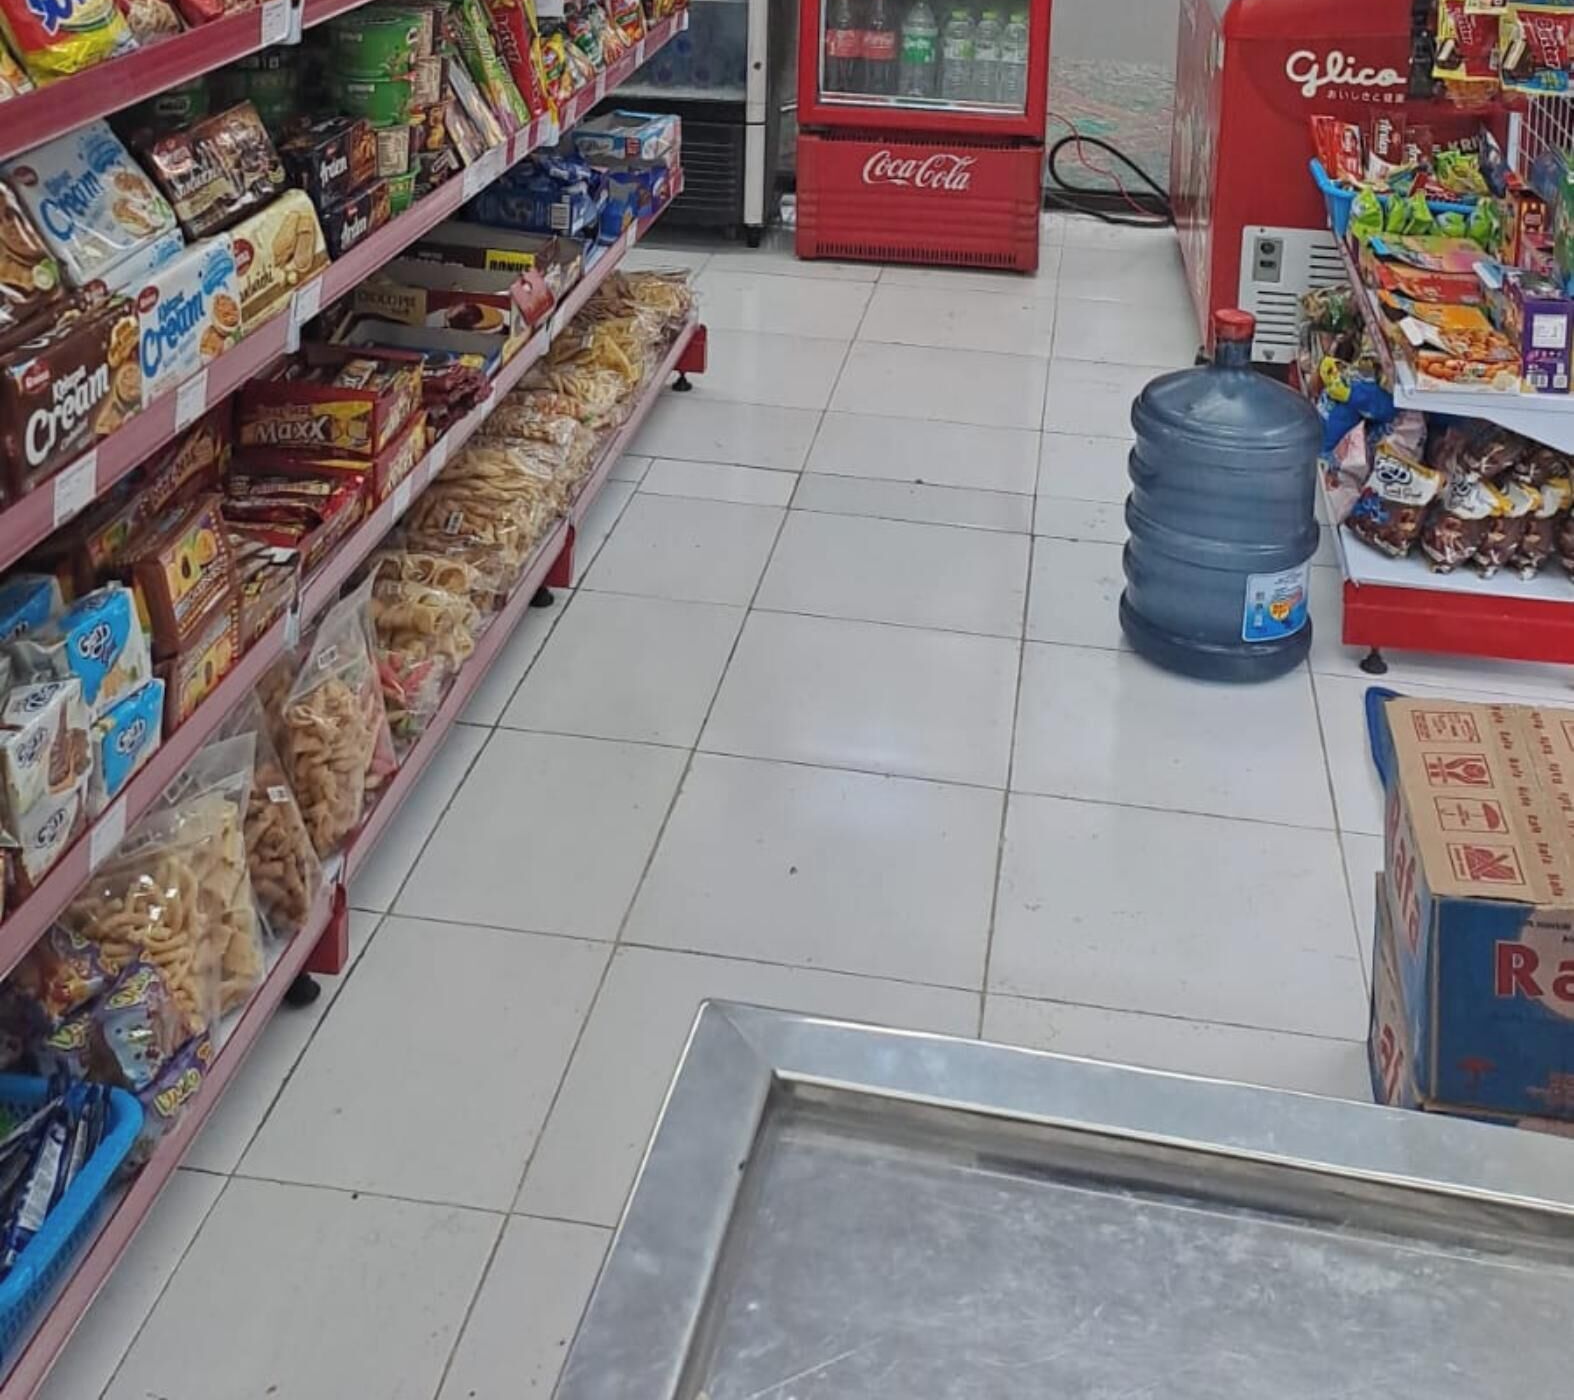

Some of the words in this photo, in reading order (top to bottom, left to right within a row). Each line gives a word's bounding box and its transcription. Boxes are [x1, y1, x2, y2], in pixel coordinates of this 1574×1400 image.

[1286, 50, 1408, 98] Glico
[862, 150, 978, 190] Coca-Cola
[141, 290, 207, 378] Cream
[25, 362, 110, 466] Cream
